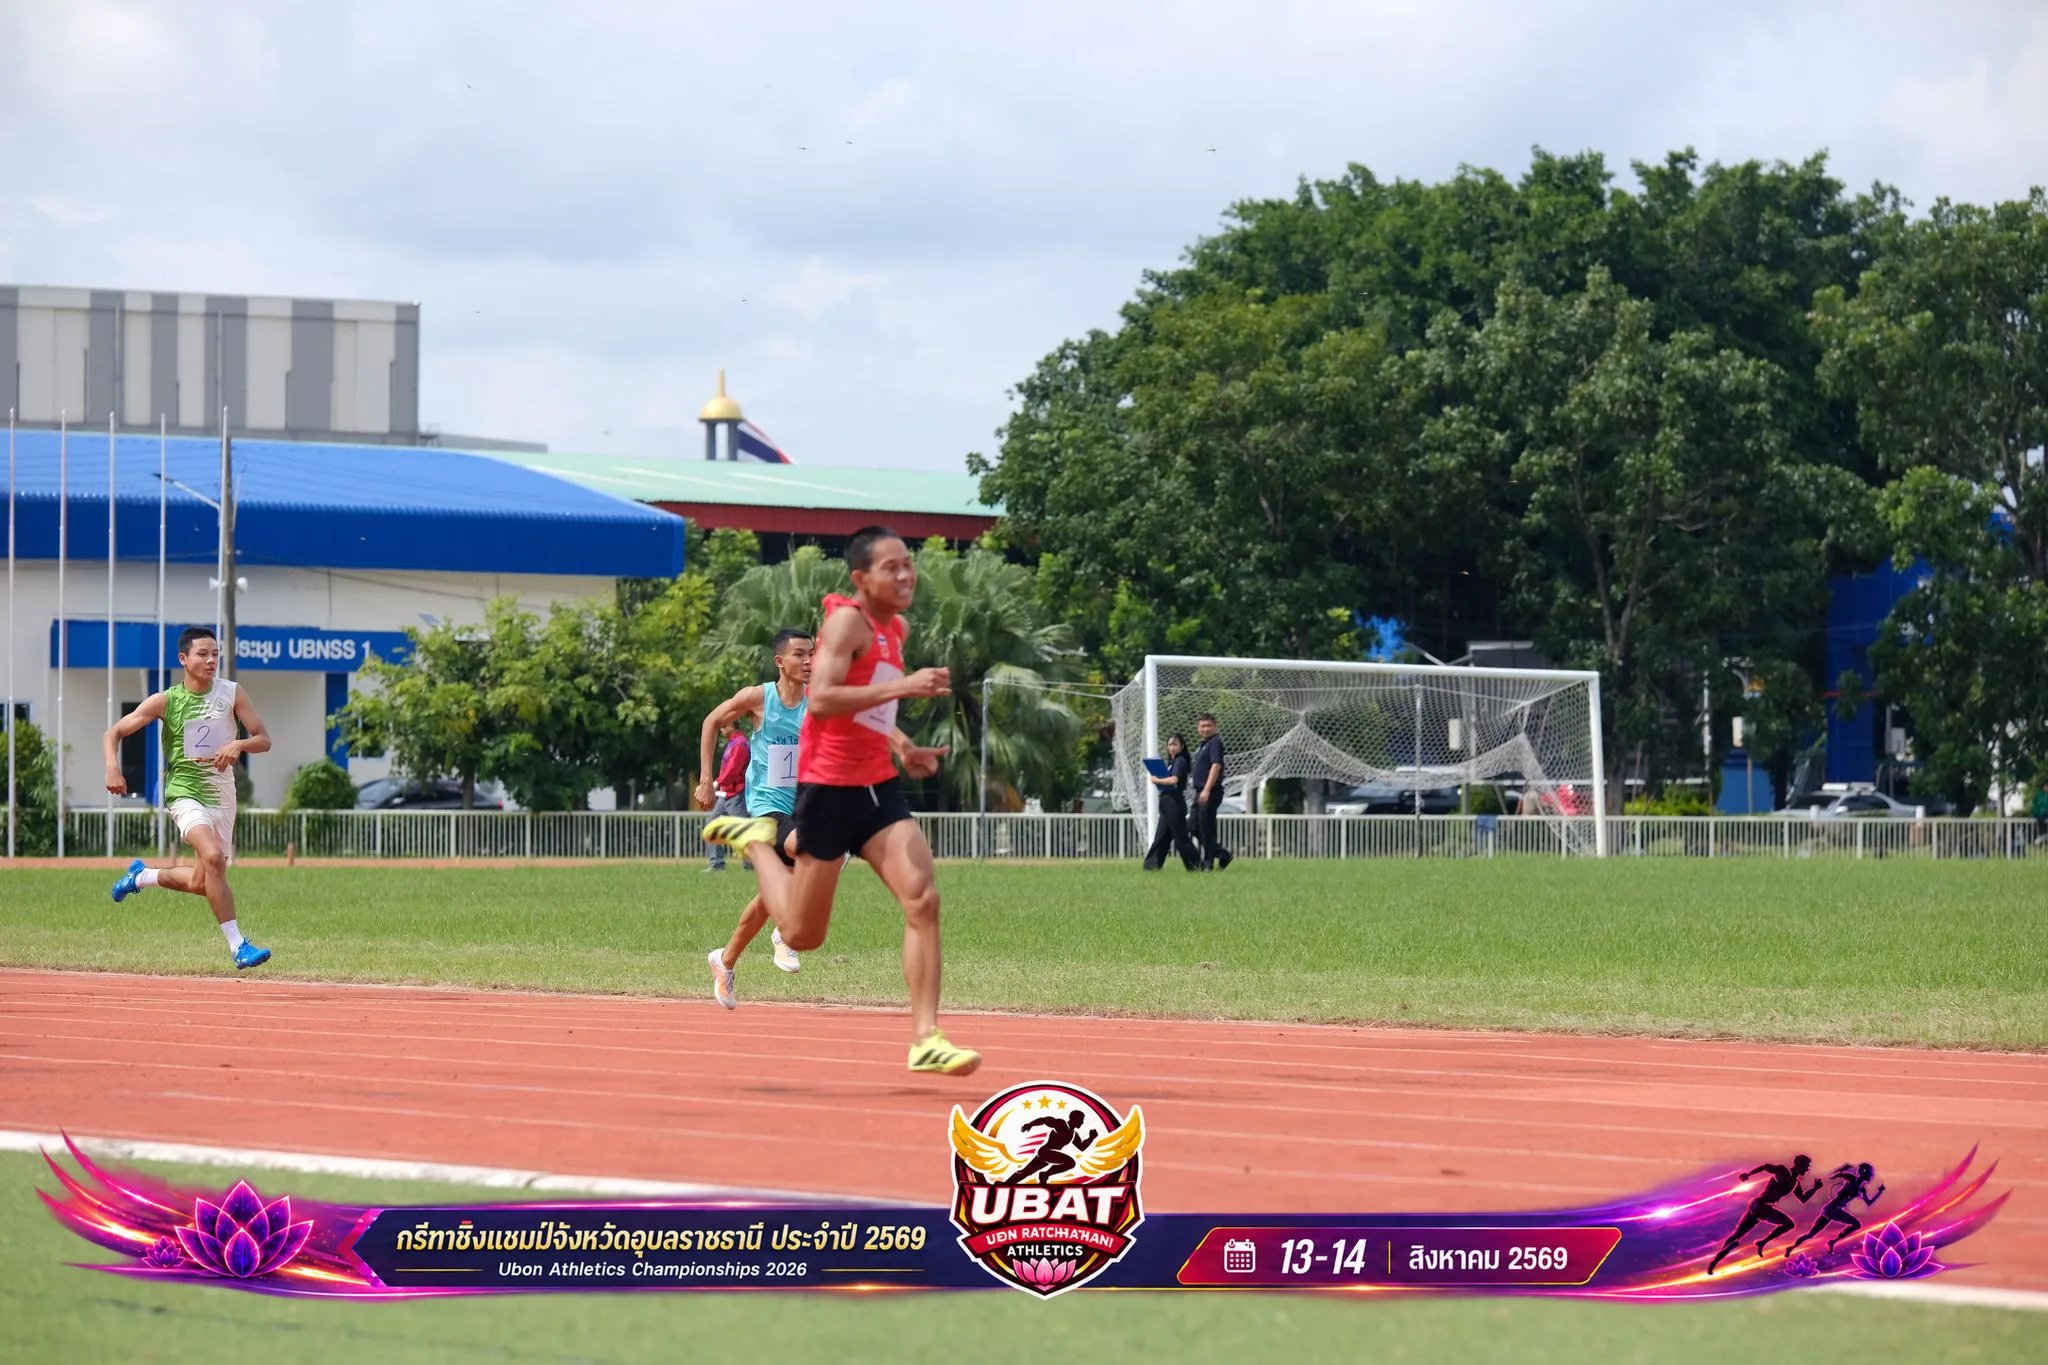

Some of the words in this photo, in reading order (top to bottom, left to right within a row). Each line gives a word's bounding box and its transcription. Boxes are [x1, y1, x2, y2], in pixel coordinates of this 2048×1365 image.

[288, 638, 355, 660] UBNSS
[361, 640, 371, 658] 1
[194, 725, 210, 748] 2
[781, 751, 797, 779] 1
